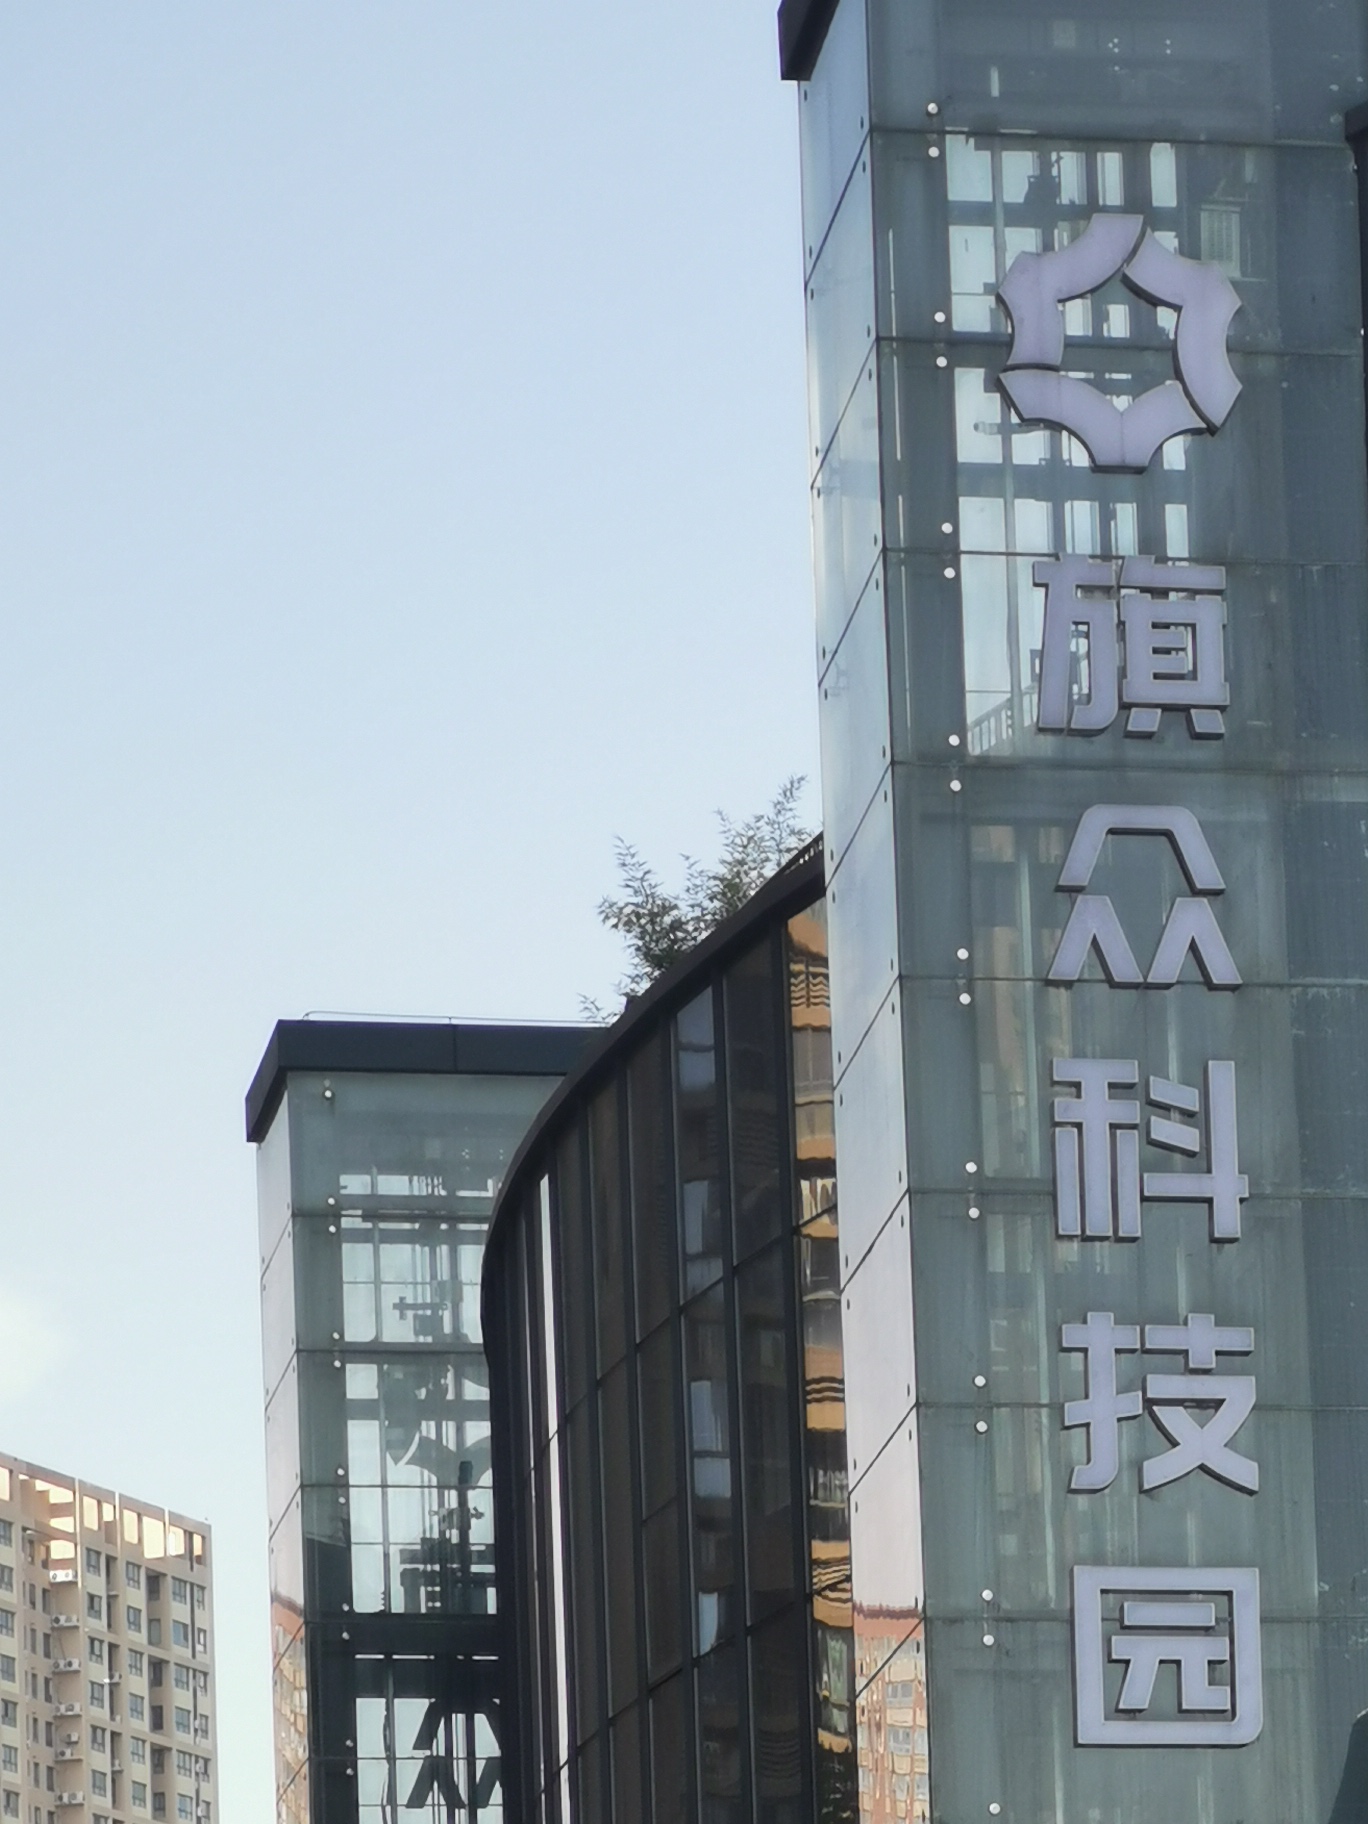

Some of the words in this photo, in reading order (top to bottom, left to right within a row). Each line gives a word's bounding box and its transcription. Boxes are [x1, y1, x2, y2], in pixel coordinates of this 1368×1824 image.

[1032, 554, 1263, 1748] 旗众科技园
